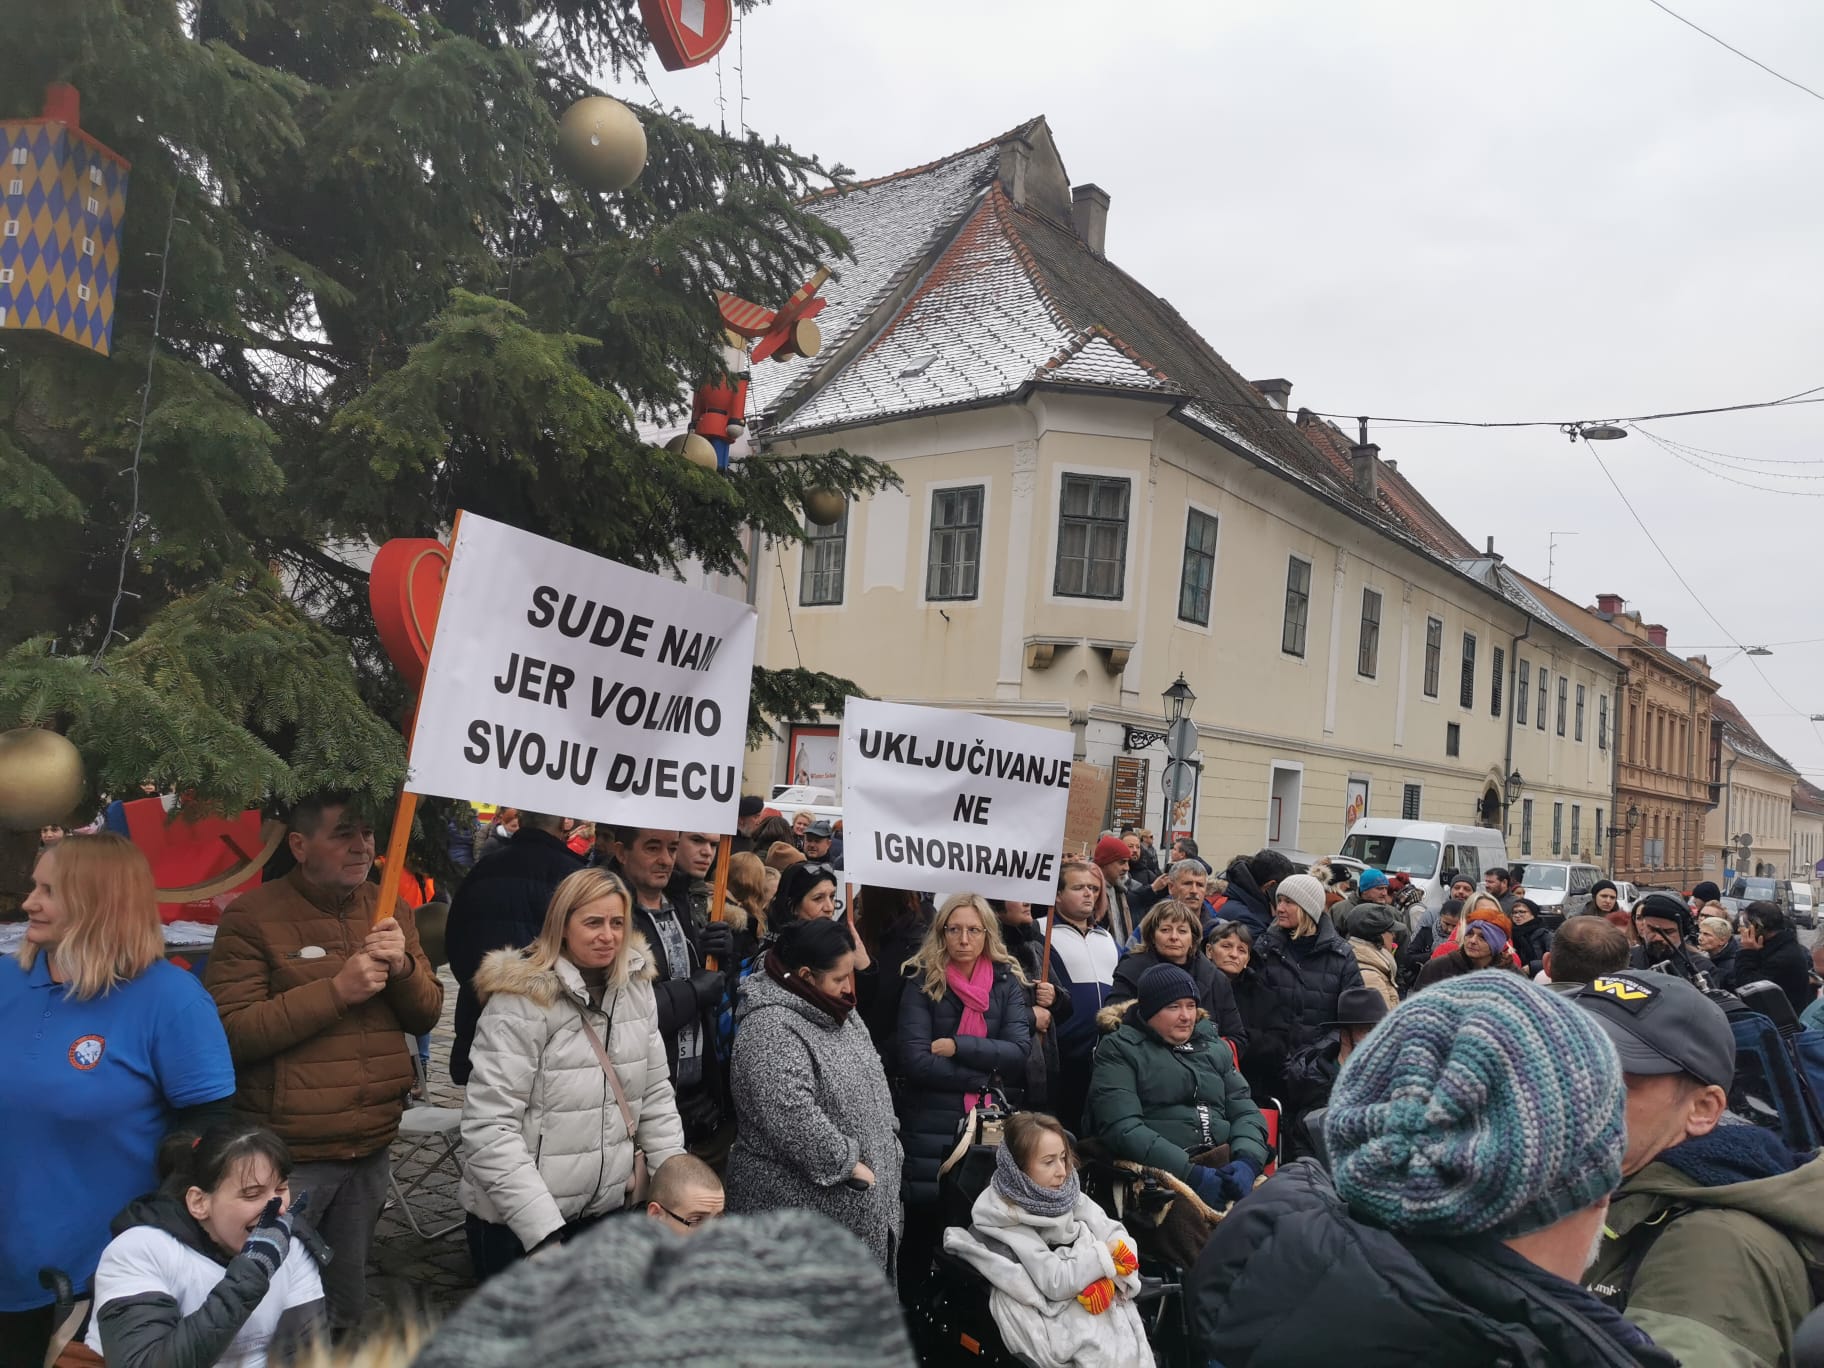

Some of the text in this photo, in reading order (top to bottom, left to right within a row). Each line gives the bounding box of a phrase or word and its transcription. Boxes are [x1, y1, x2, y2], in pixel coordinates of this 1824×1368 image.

[528, 586, 654, 657] SUDE
[494, 653, 721, 736] JER VOLIMO
[464, 720, 734, 802] SVOJU DJECU
[859, 728, 1071, 789] UKLJUČIVANJE
[953, 793, 992, 825] NE
[874, 831, 1055, 881] IGNORIRANJE
